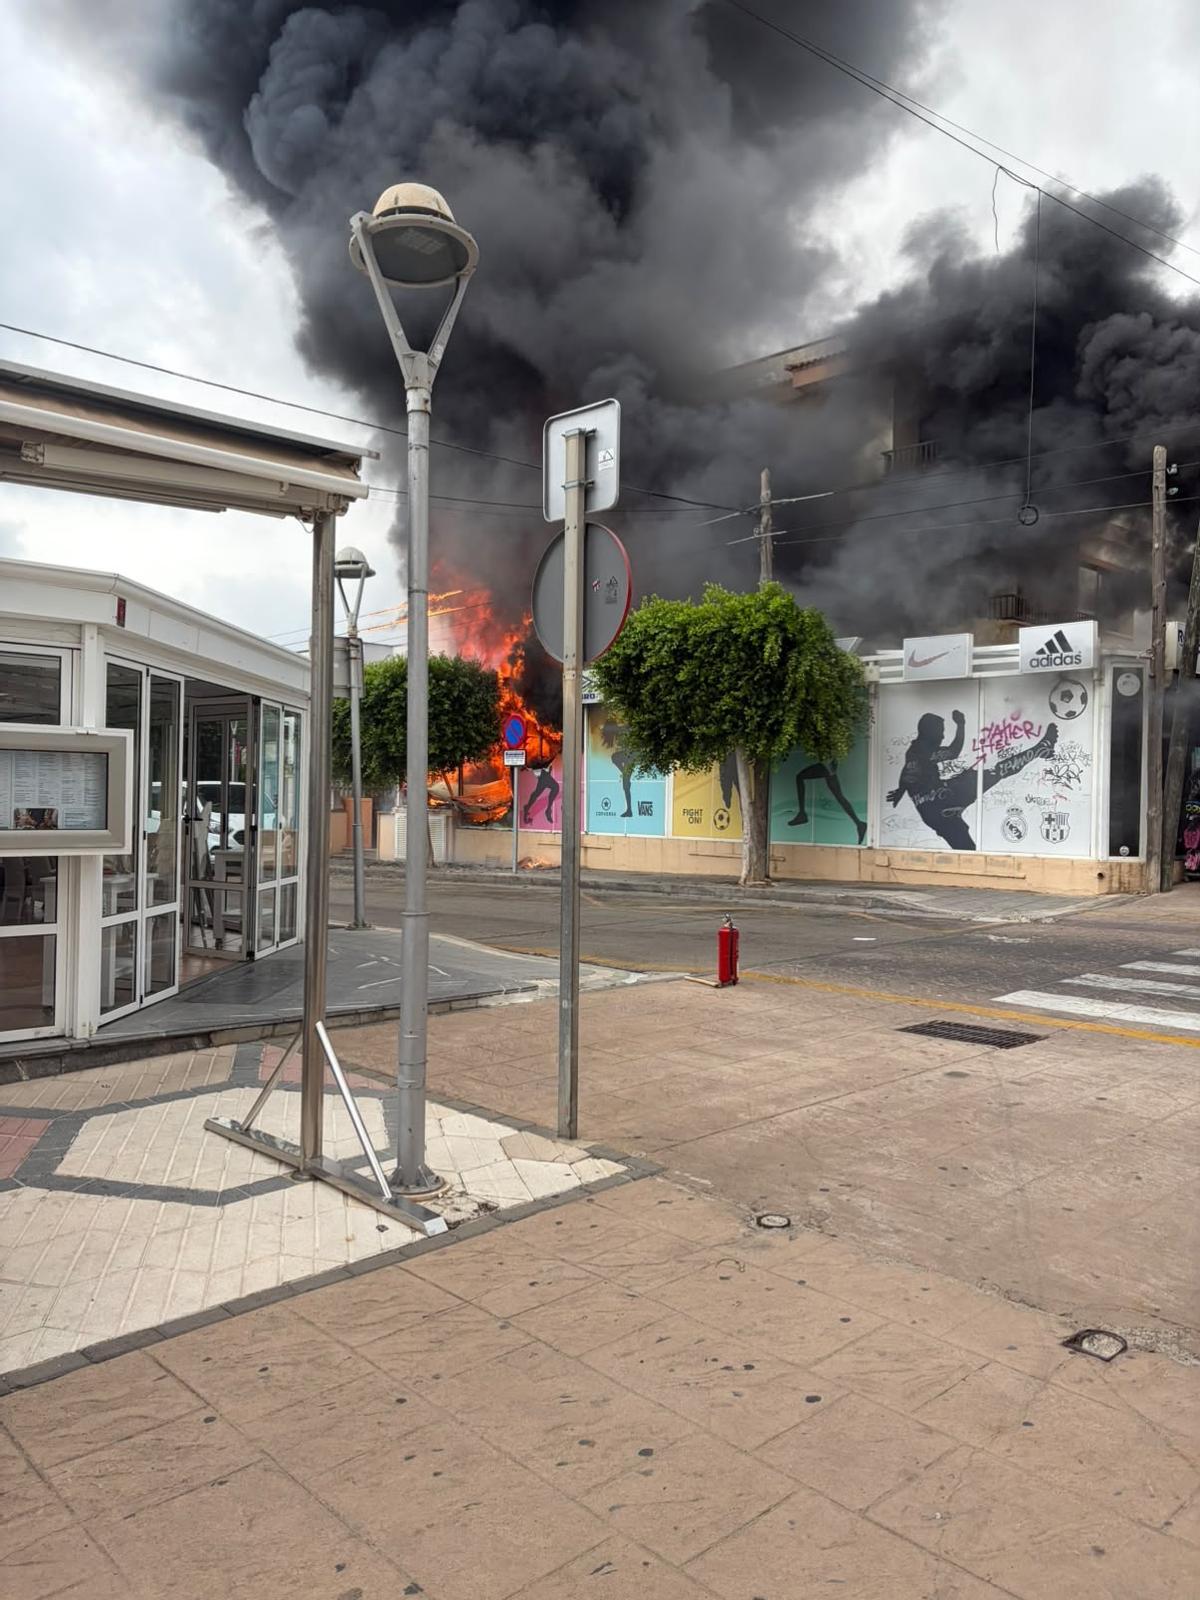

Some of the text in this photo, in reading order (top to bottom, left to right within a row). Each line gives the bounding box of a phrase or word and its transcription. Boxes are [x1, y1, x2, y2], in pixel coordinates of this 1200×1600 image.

[1029, 653, 1082, 668] adidas
[638, 801, 653, 817] VANS
[682, 808, 704, 817] FIGHT
